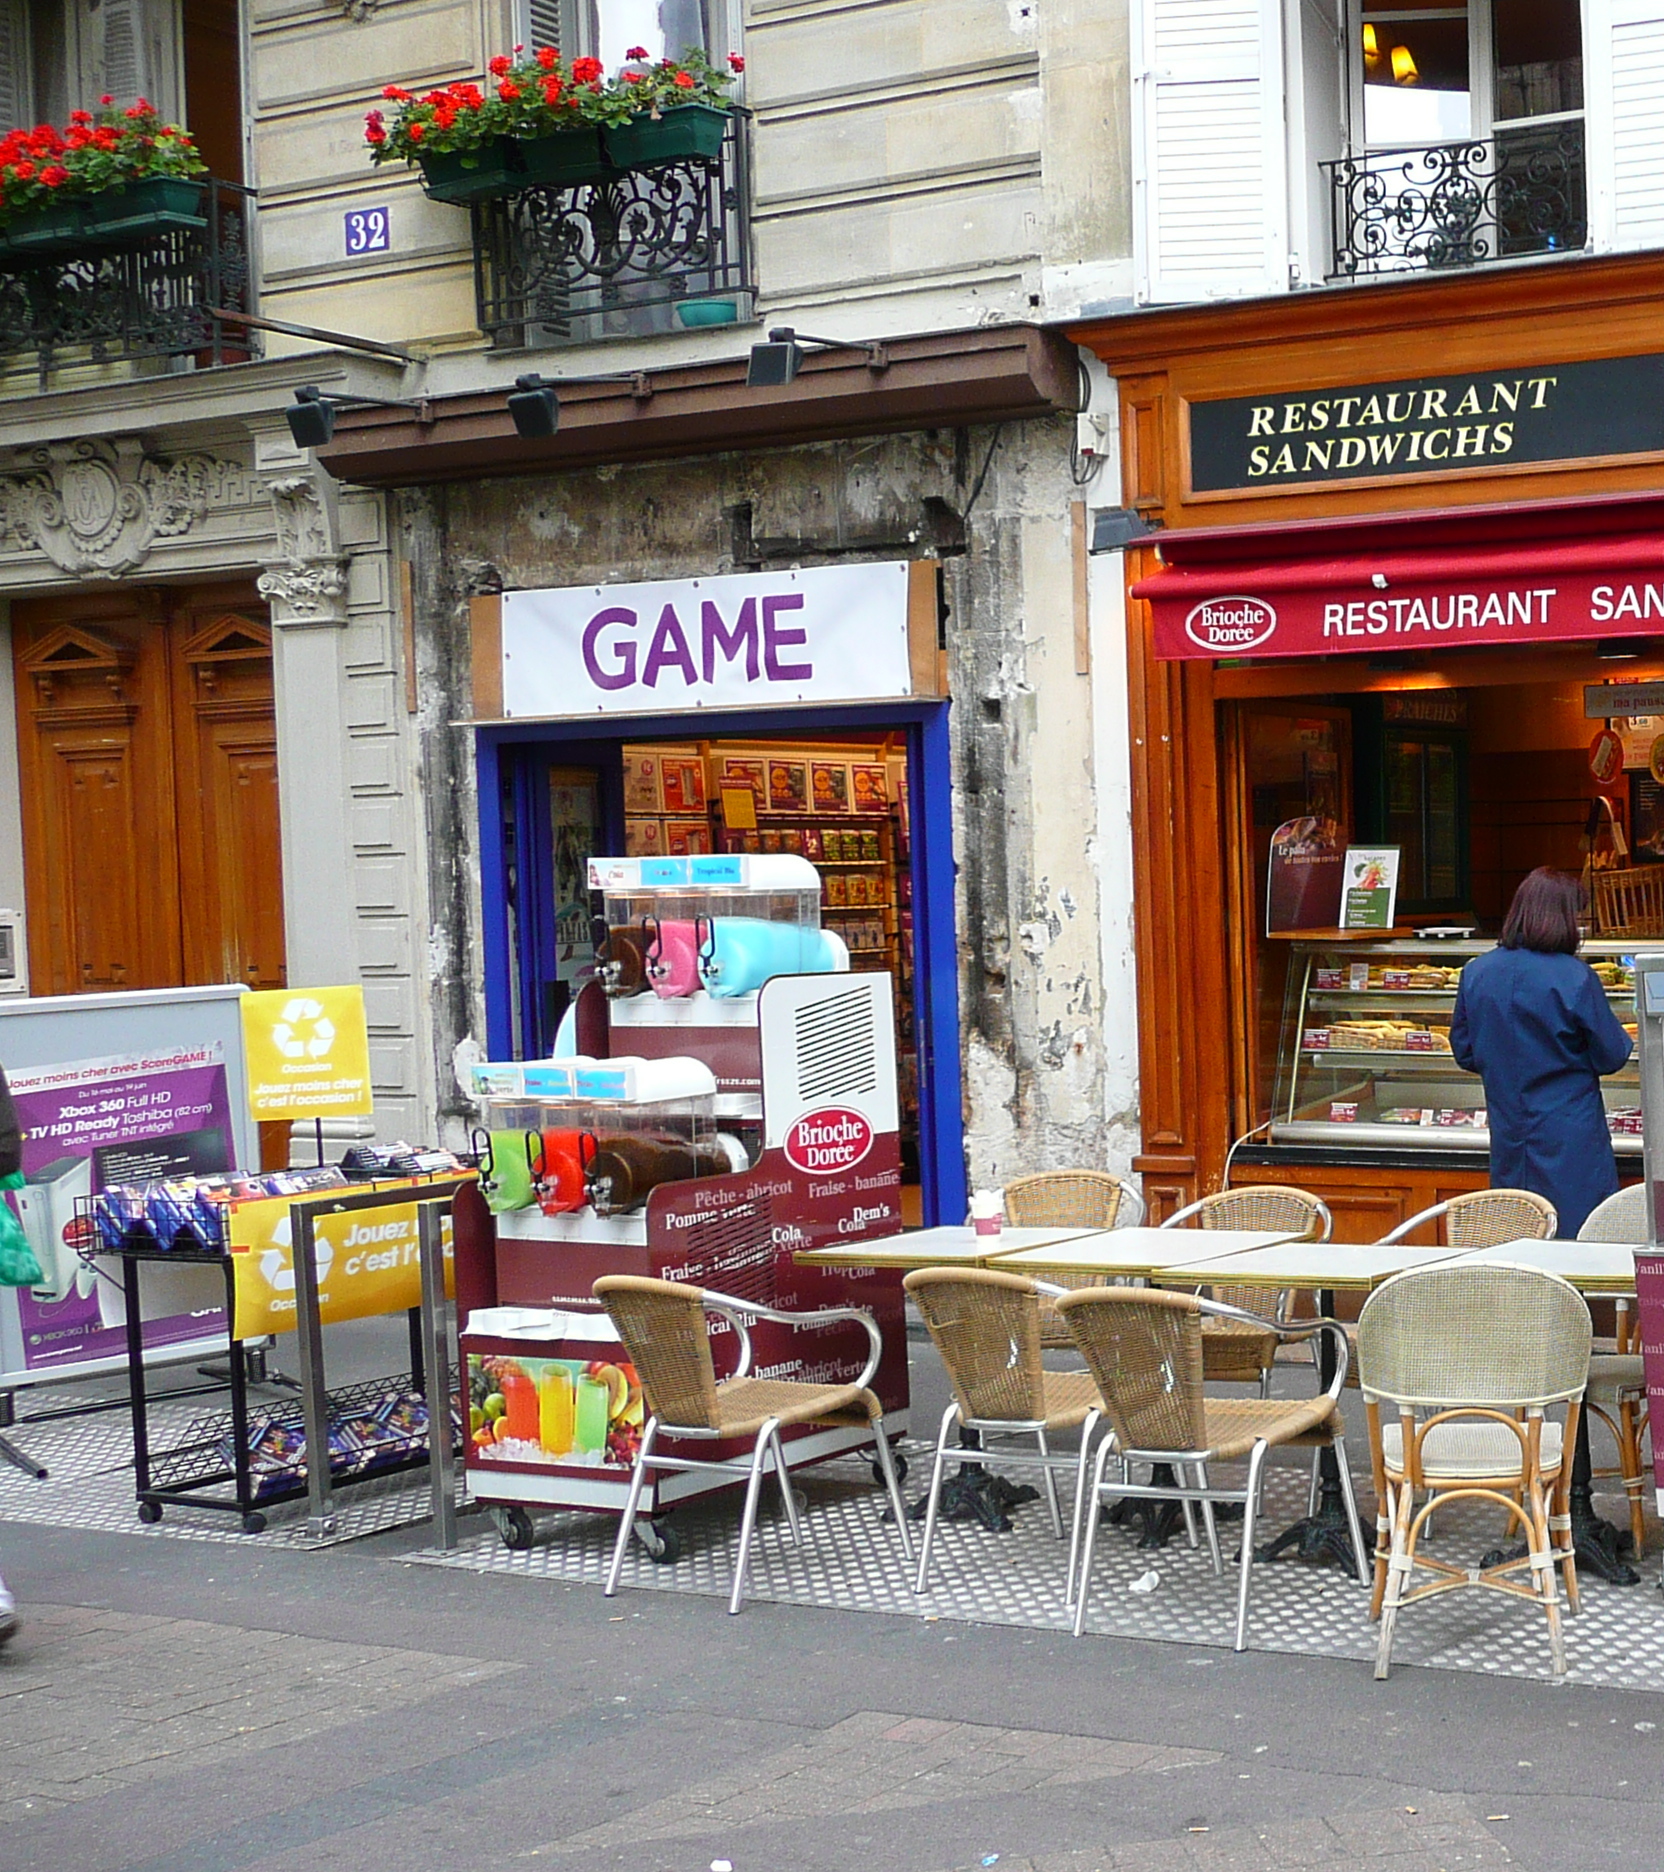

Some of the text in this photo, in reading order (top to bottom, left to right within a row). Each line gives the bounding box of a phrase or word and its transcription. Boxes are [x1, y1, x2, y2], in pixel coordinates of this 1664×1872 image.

[350, 212, 385, 250] 32
[1247, 377, 1558, 438] RESTAURANT
[1247, 421, 1515, 477] SANDWICHS
[1201, 605, 1264, 627] Brioche
[1323, 588, 1557, 637] RESTAURANT
[582, 593, 812, 691] GAME
[1208, 623, 1255, 643] Dorée
[1278, 844, 1288, 855] Le
[43, 1071, 79, 1084] moins
[81, 1066, 109, 1078] cher
[110, 1063, 139, 1075] avec
[140, 1051, 207, 1070] ScoreGAME
[281, 1062, 333, 1074] Occasion
[254, 1078, 363, 1095] Jouez moins cher
[58, 1091, 171, 1120] Xbox 360 Full HD
[30, 1126, 48, 1140] TV
[50, 1121, 73, 1137] HD
[75, 1115, 120, 1132] Ready
[121, 1108, 173, 1126] Toshiba
[797, 1115, 864, 1147] Brioche
[62, 1136, 89, 1147] avec
[90, 1131, 119, 1143] Tuner
[121, 1127, 137, 1139] TNT
[807, 1143, 855, 1168] Dorée
[695, 1179, 793, 1209] Pêche abricot
[808, 1175, 899, 1199] Fraise banane
[665, 1207, 718, 1230] Pomme
[838, 1216, 866, 1234] Cola
[853, 1203, 890, 1223] Dem's
[343, 1222, 409, 1248] Jouez
[772, 1224, 802, 1244] Cola
[345, 1248, 400, 1275] c'est
[706, 1317, 731, 1337] ical
[755, 1359, 803, 1380] banane
